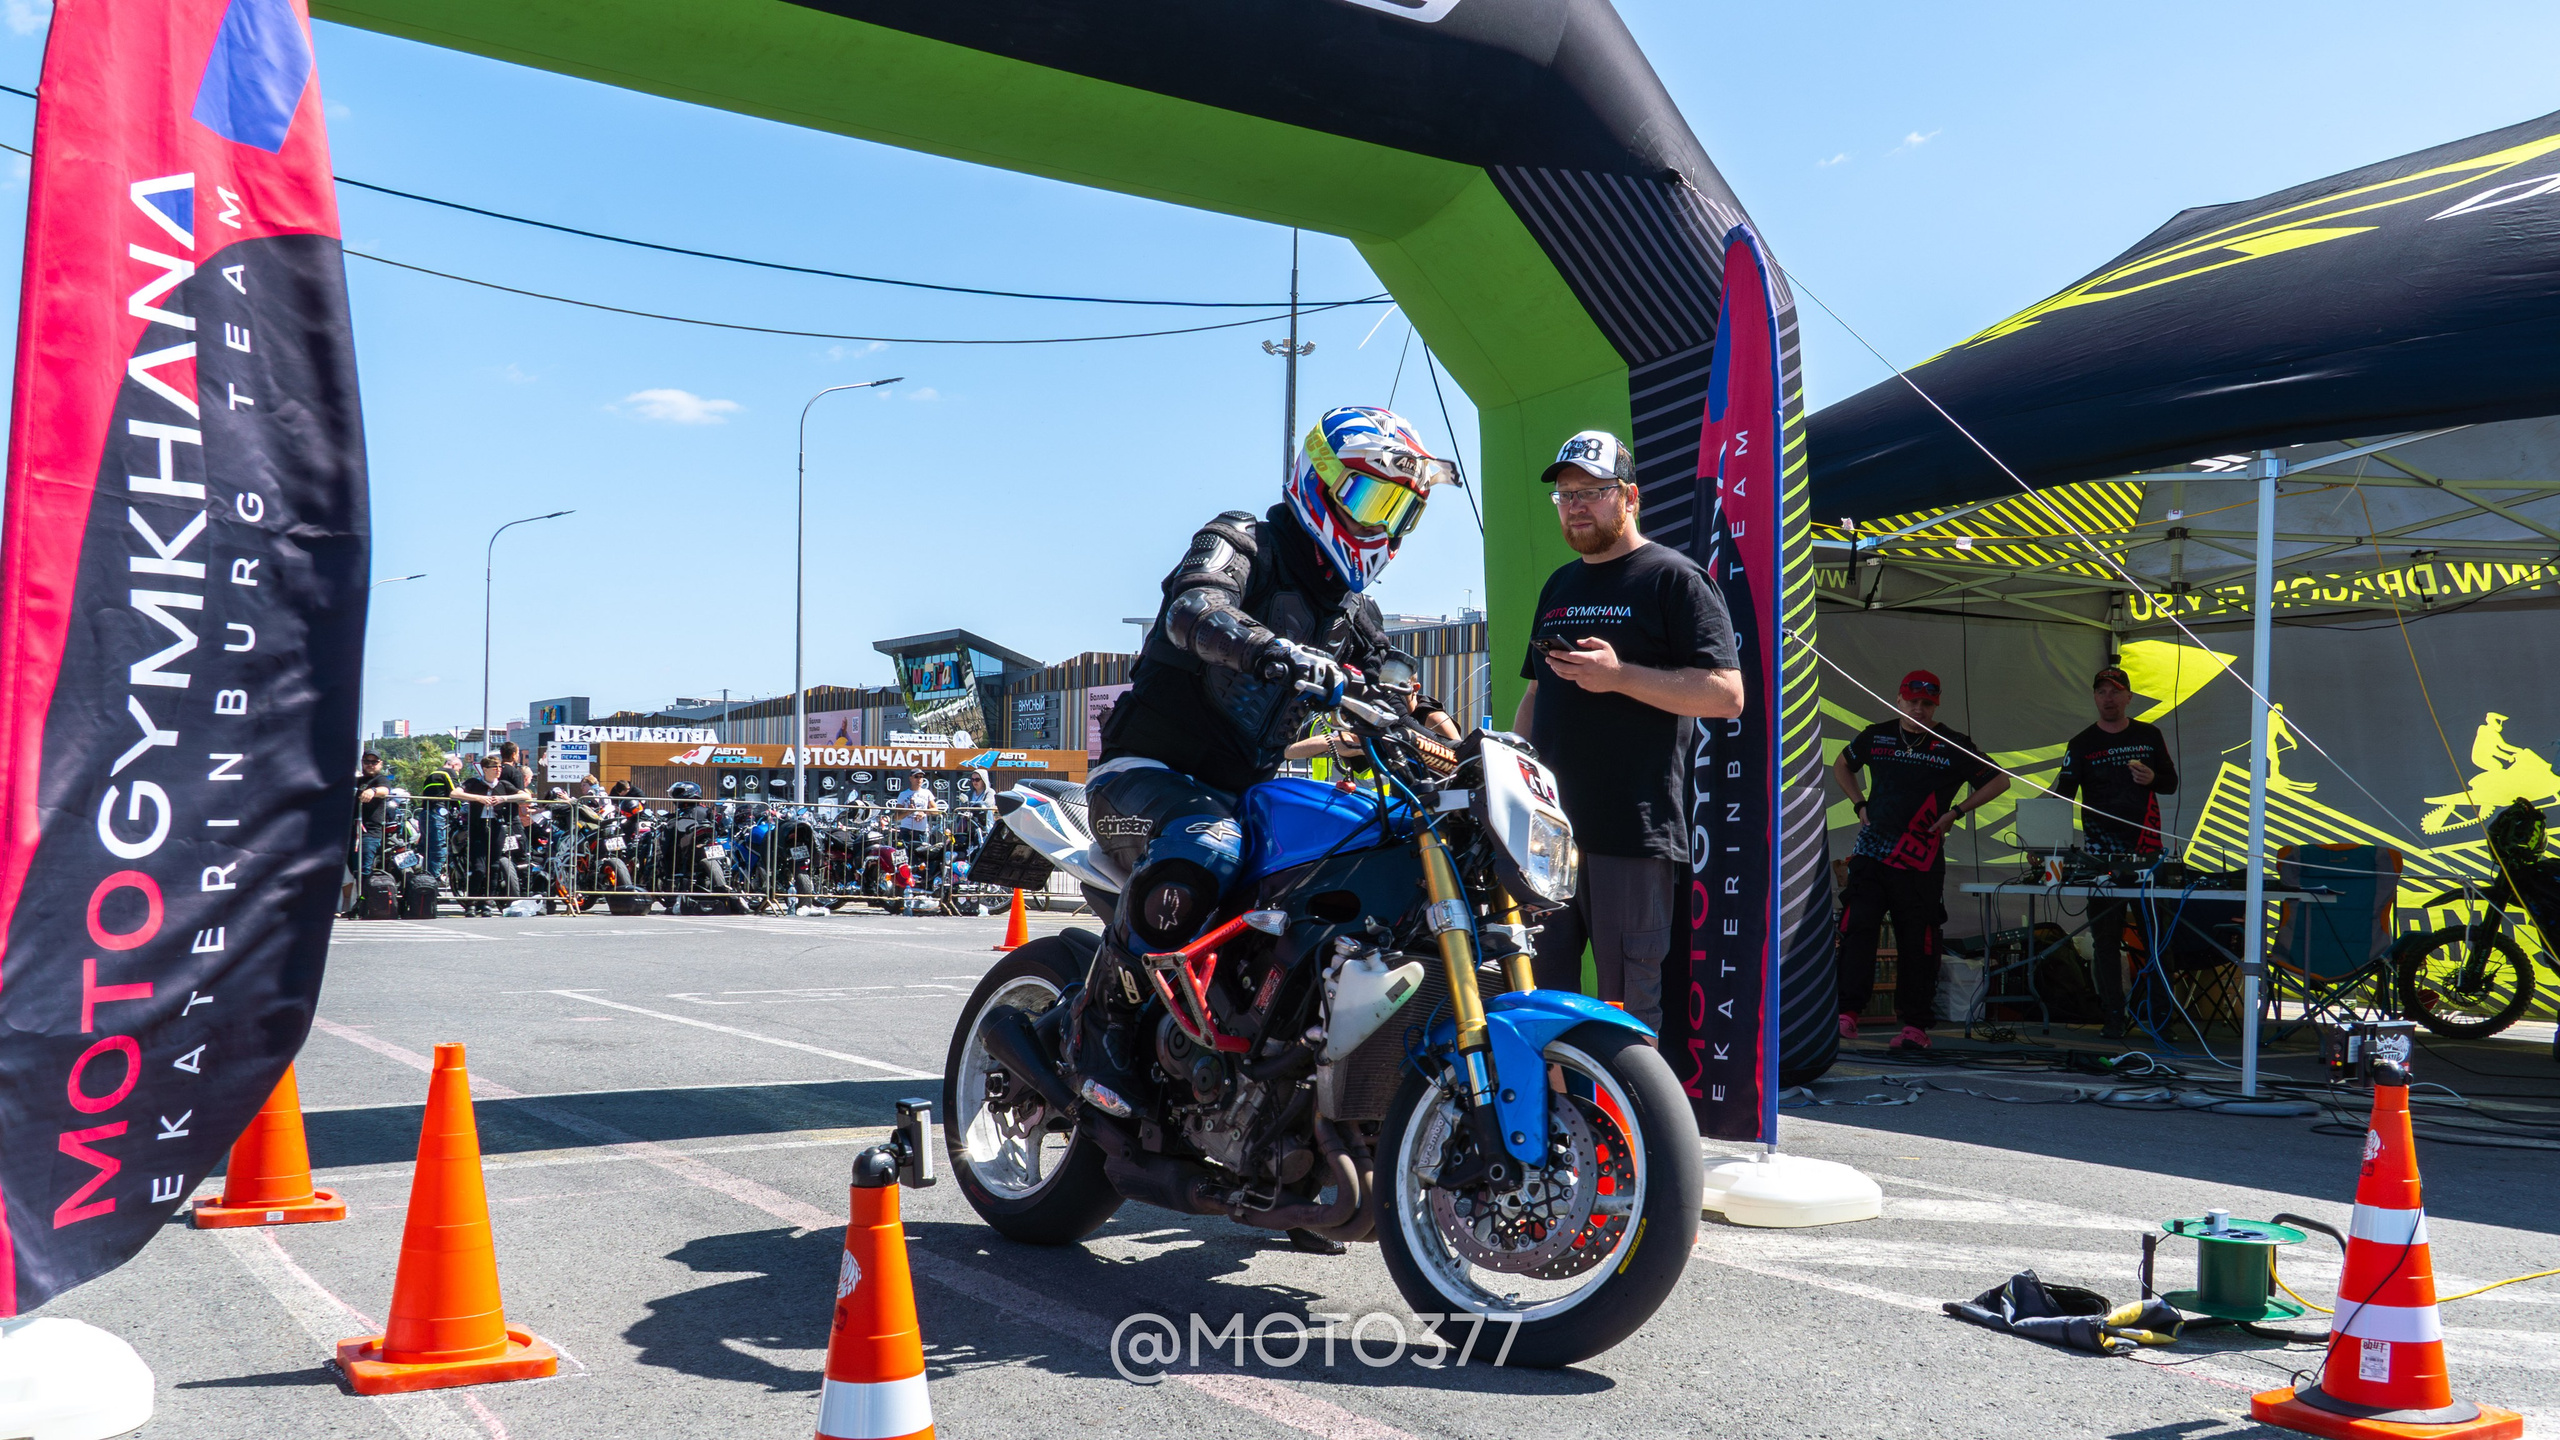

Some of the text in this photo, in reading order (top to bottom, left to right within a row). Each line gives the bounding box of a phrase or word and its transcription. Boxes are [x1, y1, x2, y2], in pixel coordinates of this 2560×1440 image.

[1729, 430, 1749, 581] TEAM
[151, 185, 264, 1203] EKATERINBURG TEAM
[714, 747, 747, 756] АВТО
[998, 752, 1027, 760] АВТО
[711, 756, 763, 765] ЯПОНЕЦ
[997, 760, 1049, 768] ЕВРОПЕЕЦ
